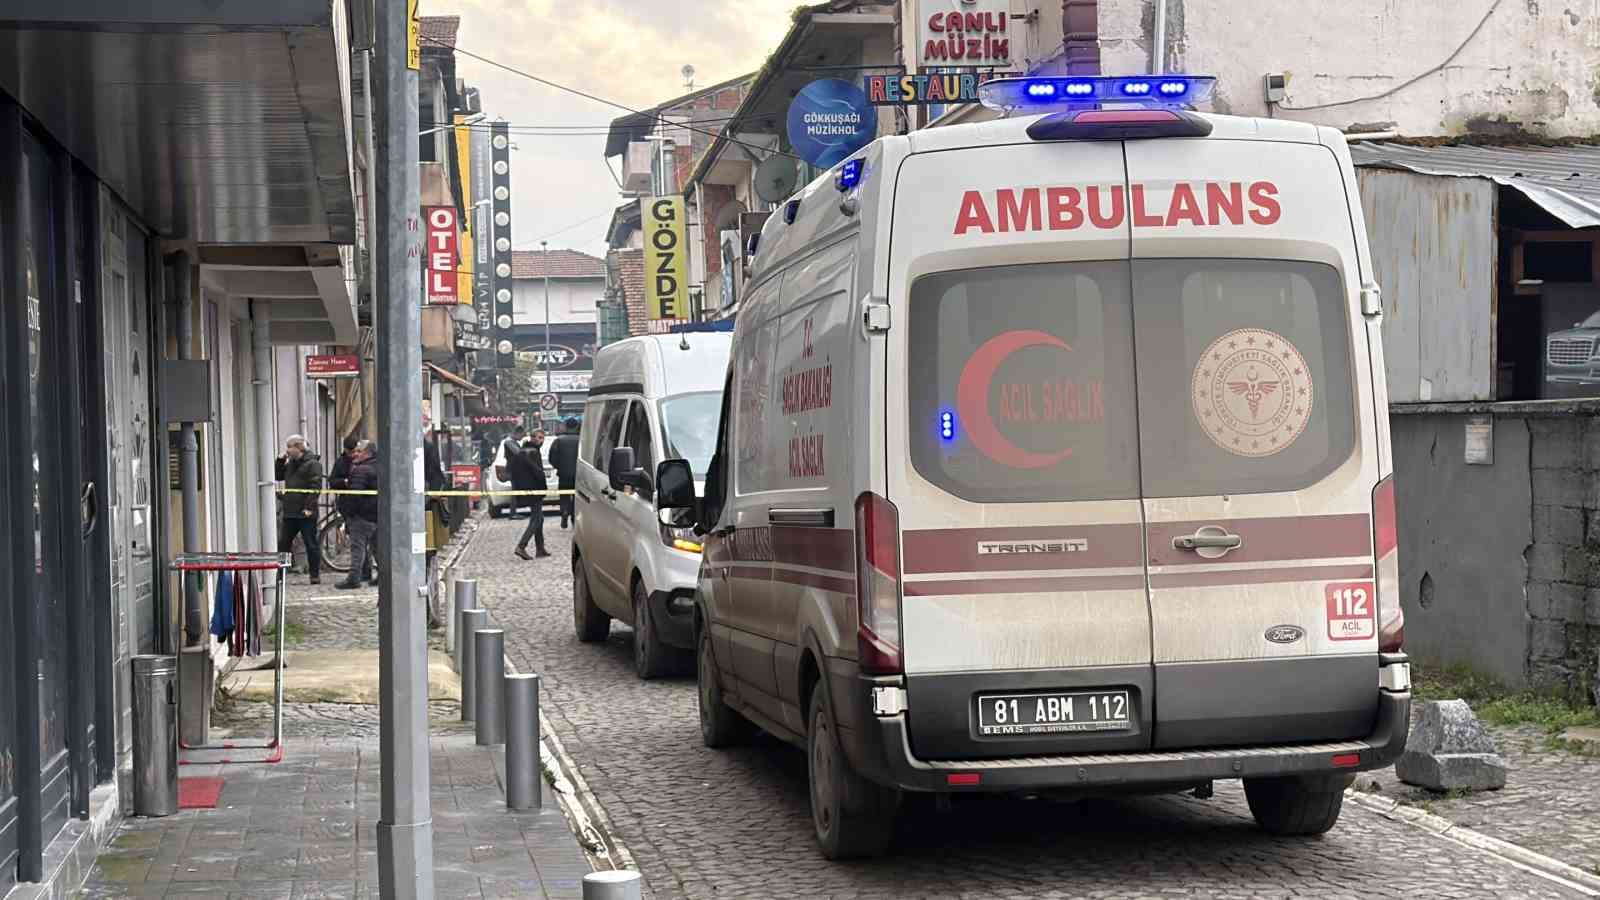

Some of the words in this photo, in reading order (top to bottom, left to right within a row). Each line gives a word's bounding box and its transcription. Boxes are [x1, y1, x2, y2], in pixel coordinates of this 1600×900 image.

[928, 12, 1006, 33] CANLI
[924, 33, 1009, 61] MÜZİK
[803, 112, 861, 125] GÖKKUŞAĞI
[807, 124, 859, 135] MÜZİKHOL
[953, 181, 1282, 235] AMBULANS
[430, 209, 454, 293] OTEL
[652, 199, 678, 319] GÖZDE
[981, 542, 1086, 553] TRANSIT
[1333, 588, 1368, 616] 112
[994, 699, 1019, 724] 81
[1035, 696, 1074, 723] ABM
[1089, 695, 1126, 720] 112
